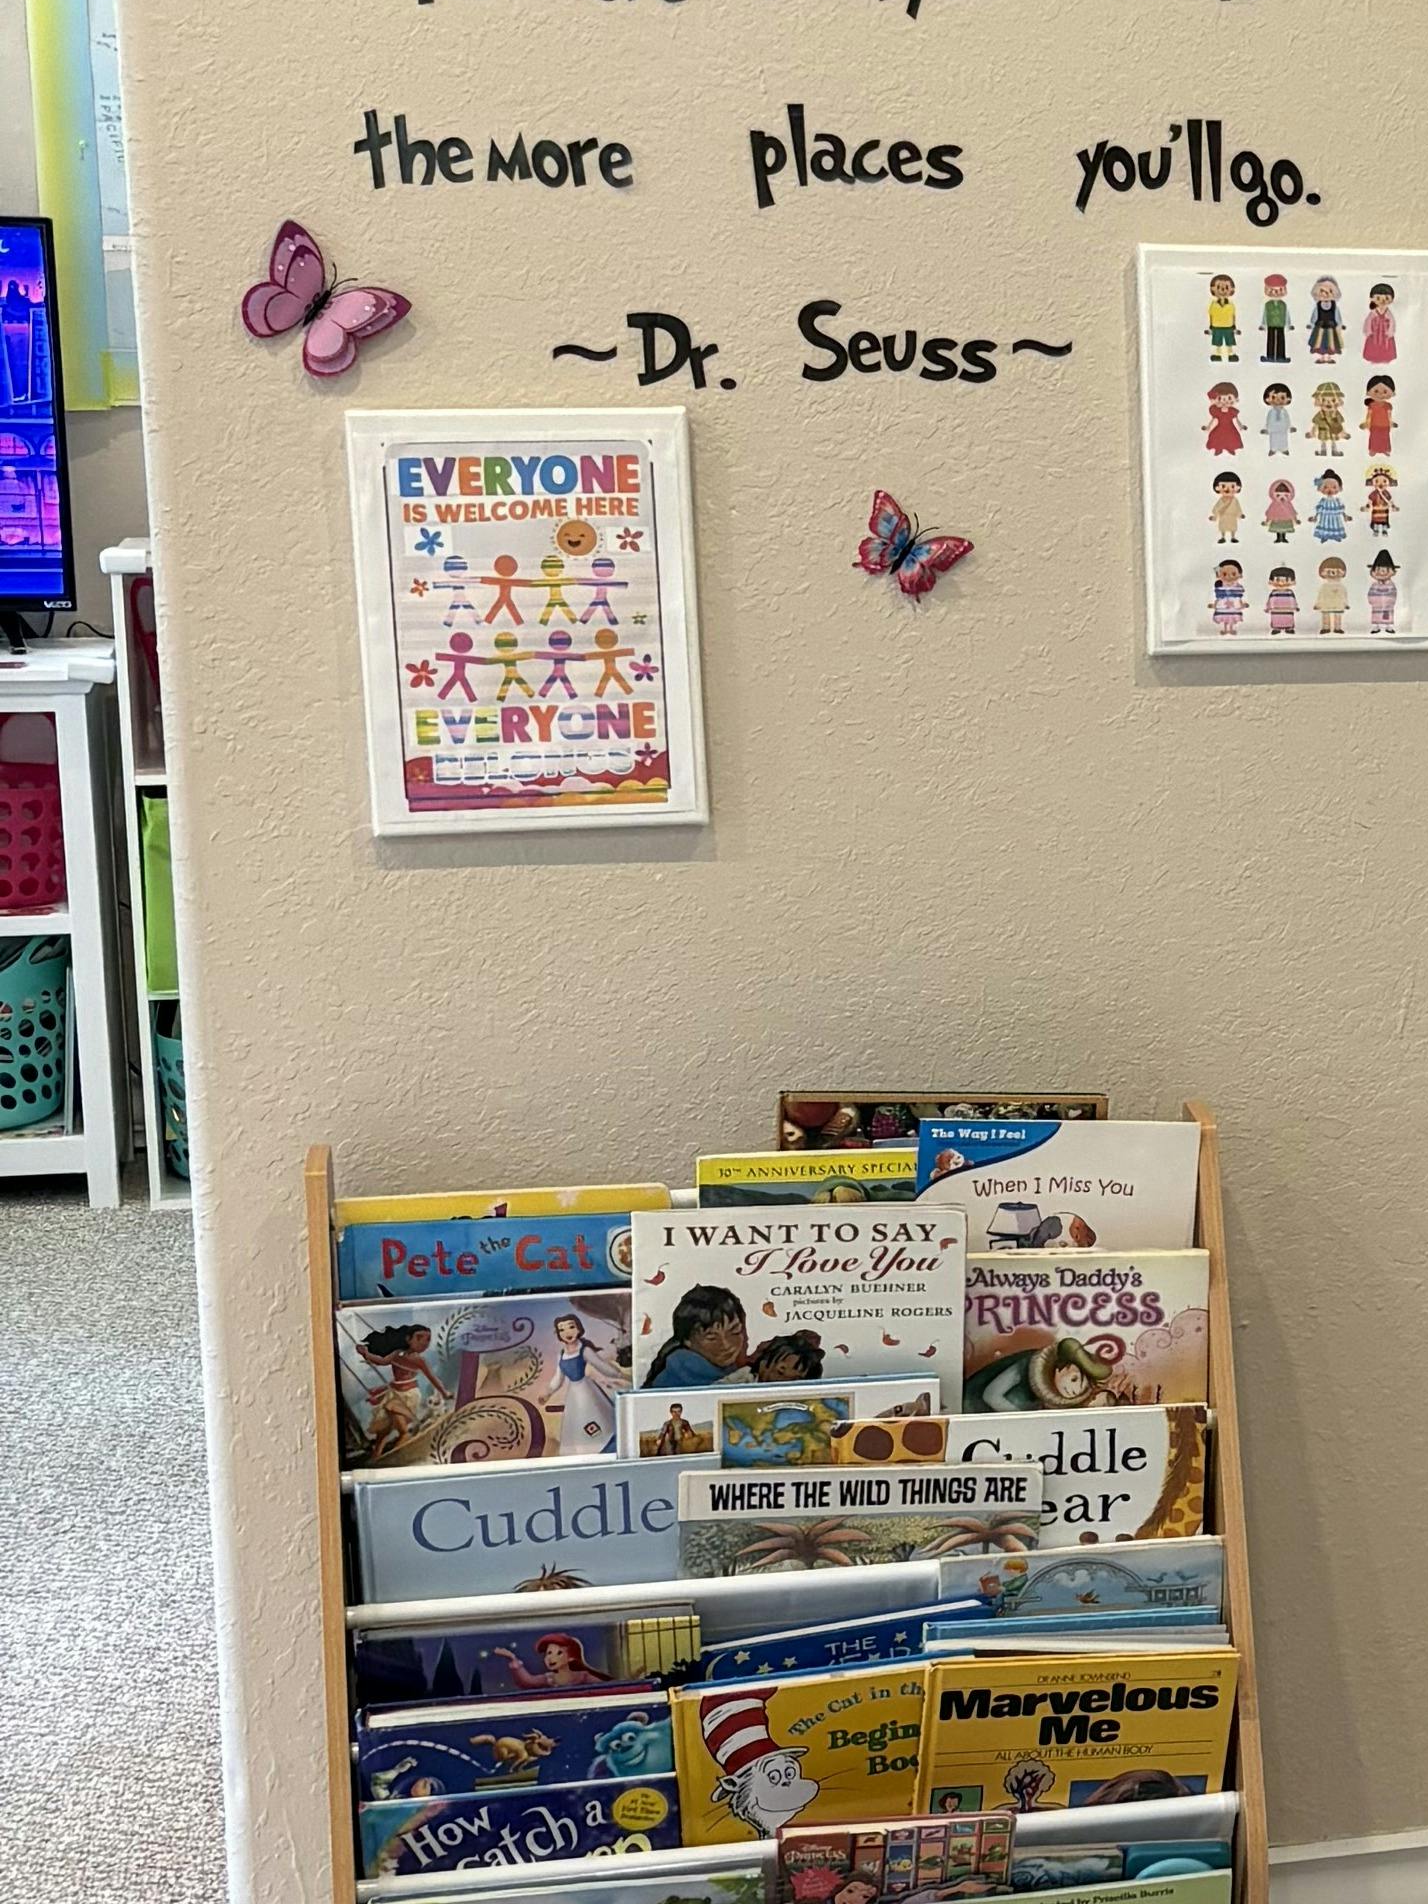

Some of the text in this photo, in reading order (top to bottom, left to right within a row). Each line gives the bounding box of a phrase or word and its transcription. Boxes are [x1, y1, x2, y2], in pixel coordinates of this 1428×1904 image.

[354, 110, 473, 189] the
[750, 104, 963, 208] places
[1076, 119, 1221, 213] you'll
[1230, 151, 1321, 227] go.
[398, 454, 641, 497] EVERYONE
[402, 497, 640, 524] IS WELCOME HERE
[415, 702, 656, 746] EVERYONE
[931, 1128, 955, 1138] The
[958, 1128, 989, 1141] Way
[746, 1164, 855, 1178] ANNIVERSARY
[972, 1176, 1135, 1197] When I Miss You
[663, 1222, 938, 1247] I WANT TO SAY
[381, 1234, 595, 1280] Pete the Cat
[735, 1246, 943, 1282] I Love You
[770, 1282, 927, 1297] CARALYN BUEHNER
[966, 1265, 1143, 1293] Always Daddy's
[784, 1306, 953, 1323] JACQUELINE ROGERS
[709, 1475, 1028, 1512] WHERE THE WILD THINGS ARE
[411, 1480, 676, 1553] Cuddle
[824, 1636, 877, 1656] THE
[788, 1681, 926, 1736] The Cat in th
[939, 1682, 1219, 1721] Marvelous
[1038, 1714, 1121, 1746] Me
[994, 1744, 1154, 1761] ALL ABOUT THE HUMAN BODY
[585, 1799, 608, 1828] a
[401, 1805, 494, 1869] How
